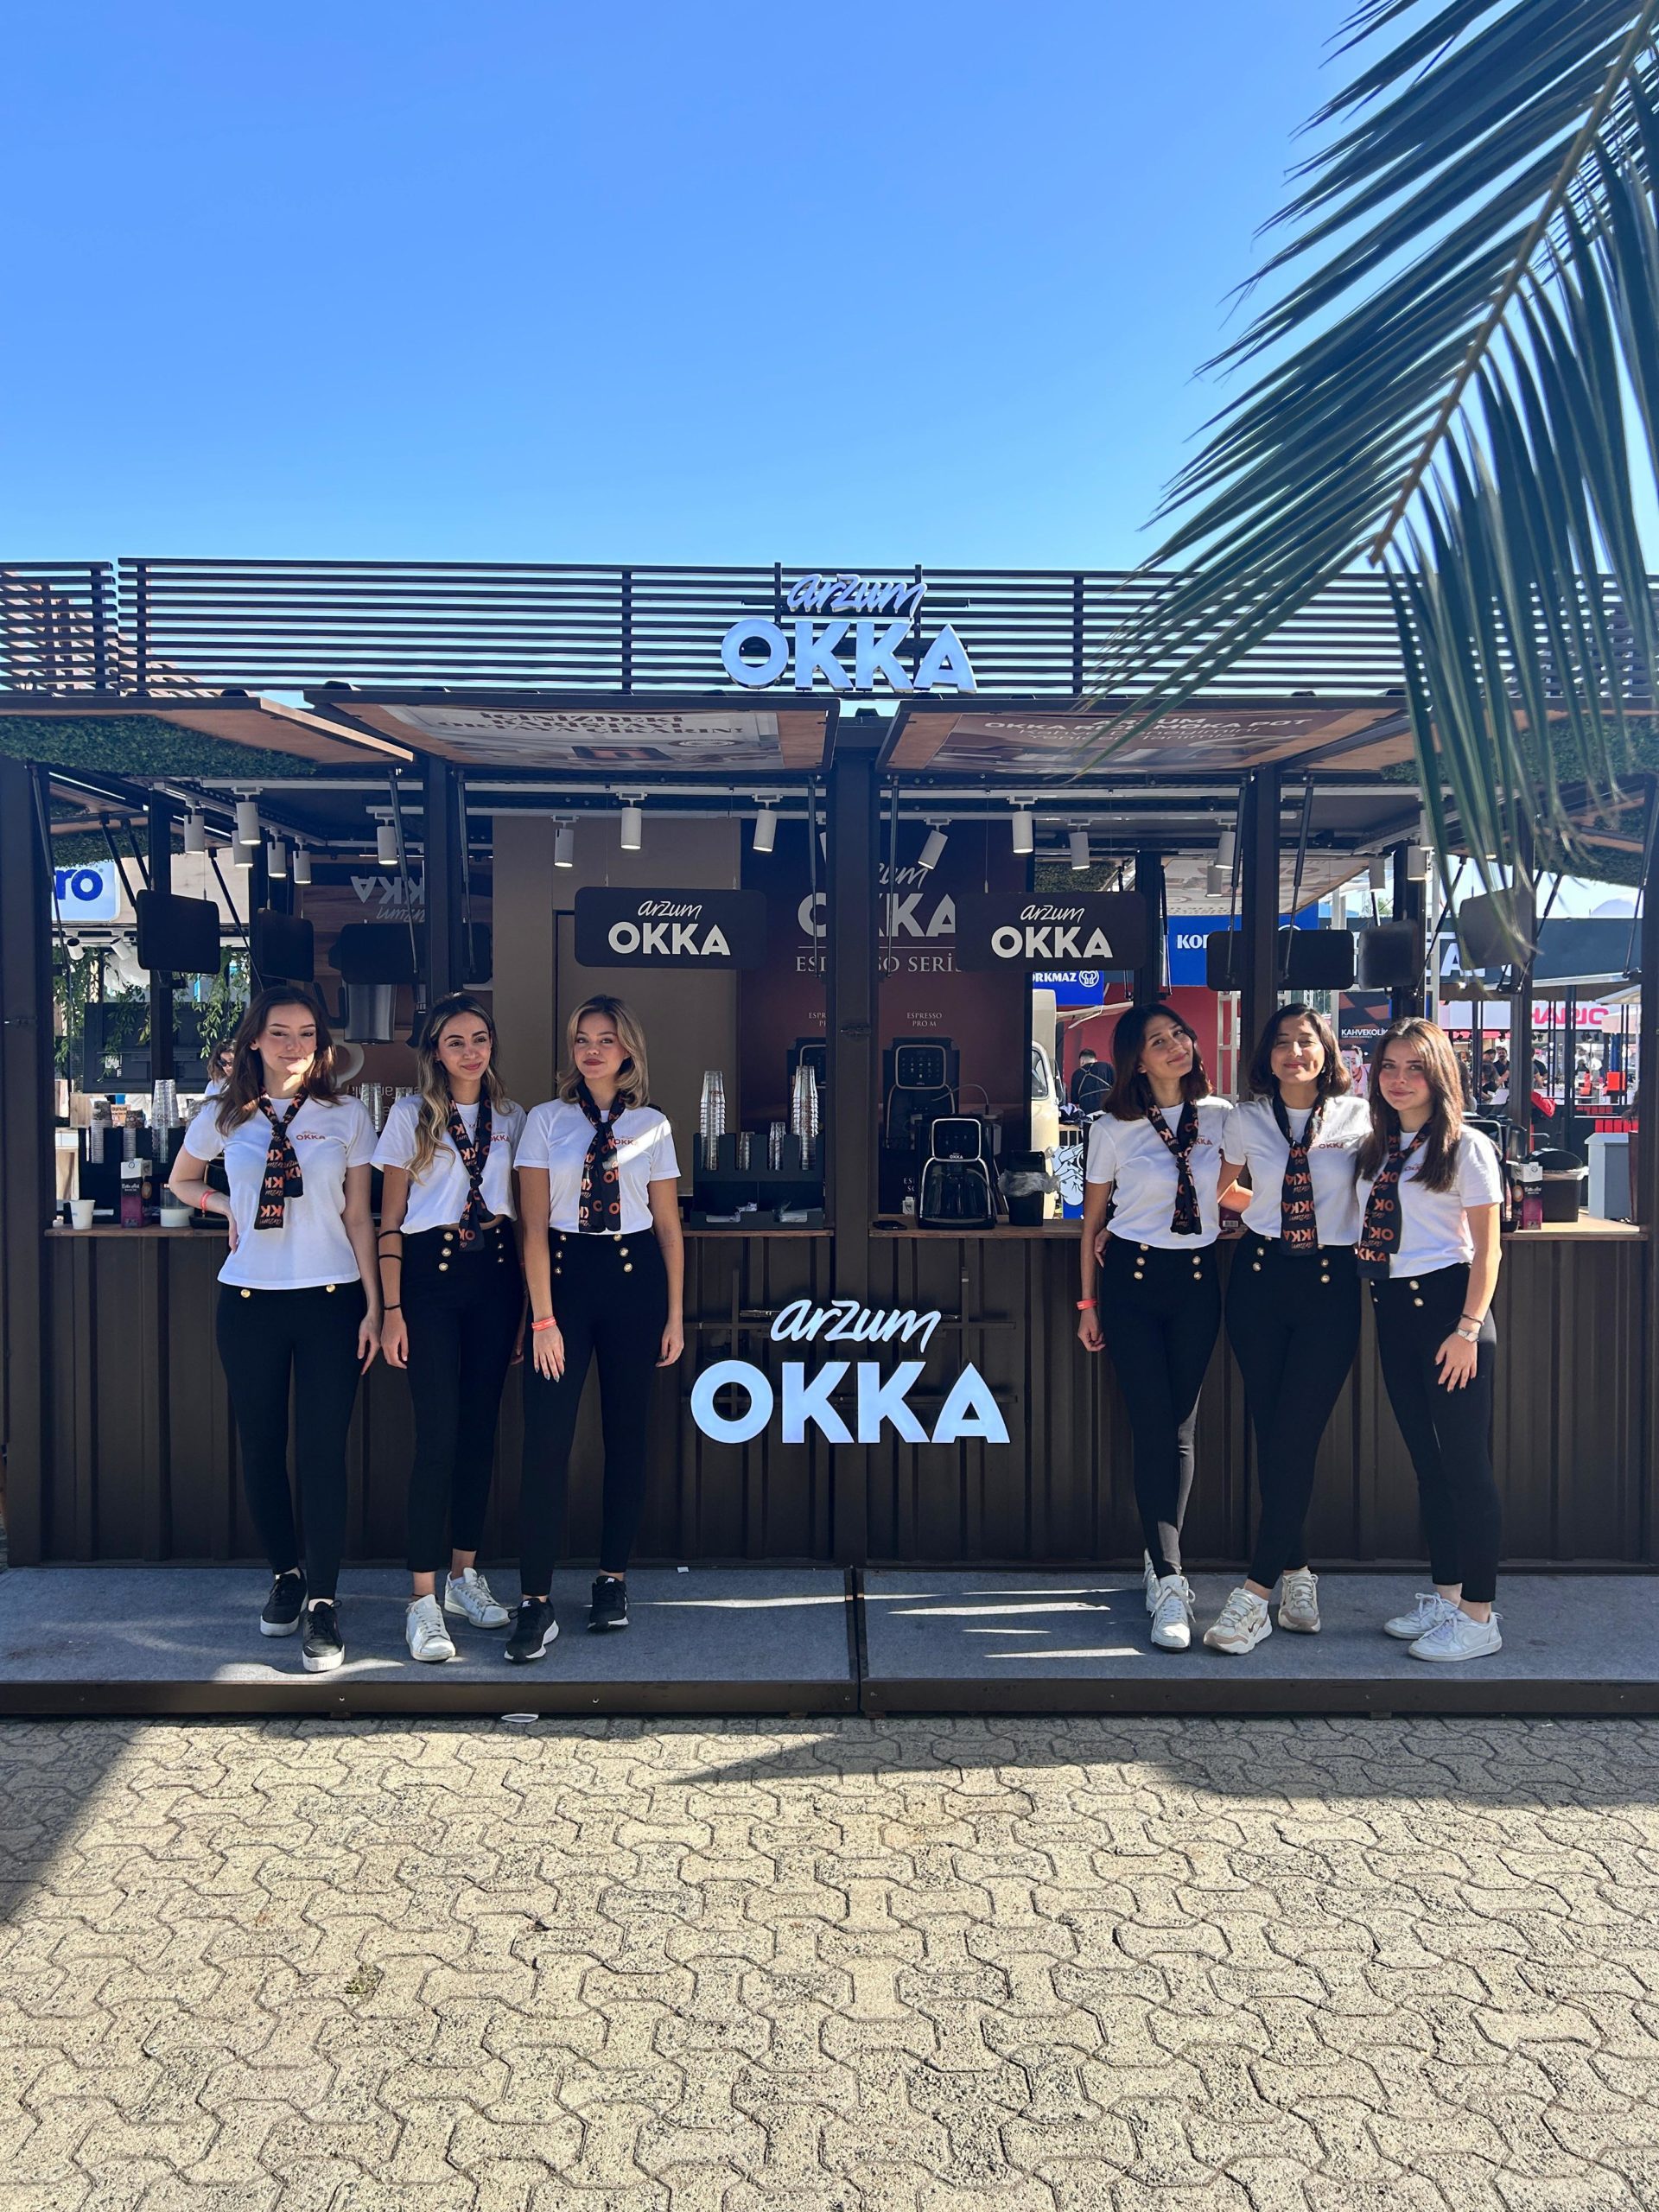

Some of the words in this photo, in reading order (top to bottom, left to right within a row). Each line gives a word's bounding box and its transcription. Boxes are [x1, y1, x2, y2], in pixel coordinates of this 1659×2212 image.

[787, 574, 927, 620] arzum
[721, 618, 977, 692] OKKA
[350, 876, 424, 904] KKA
[638, 900, 702, 920] arzum
[798, 893, 956, 937] OKA
[1020, 905, 1084, 924] arzum
[608, 921, 731, 956] OKKA
[991, 925, 1113, 958] OKKA
[908, 953, 961, 972] SERİ
[1033, 971, 1077, 982] RKMAZ
[1357, 1248, 1387, 1262] KKA
[770, 1300, 942, 1353] arzum
[690, 1359, 1010, 1444] OKKA
